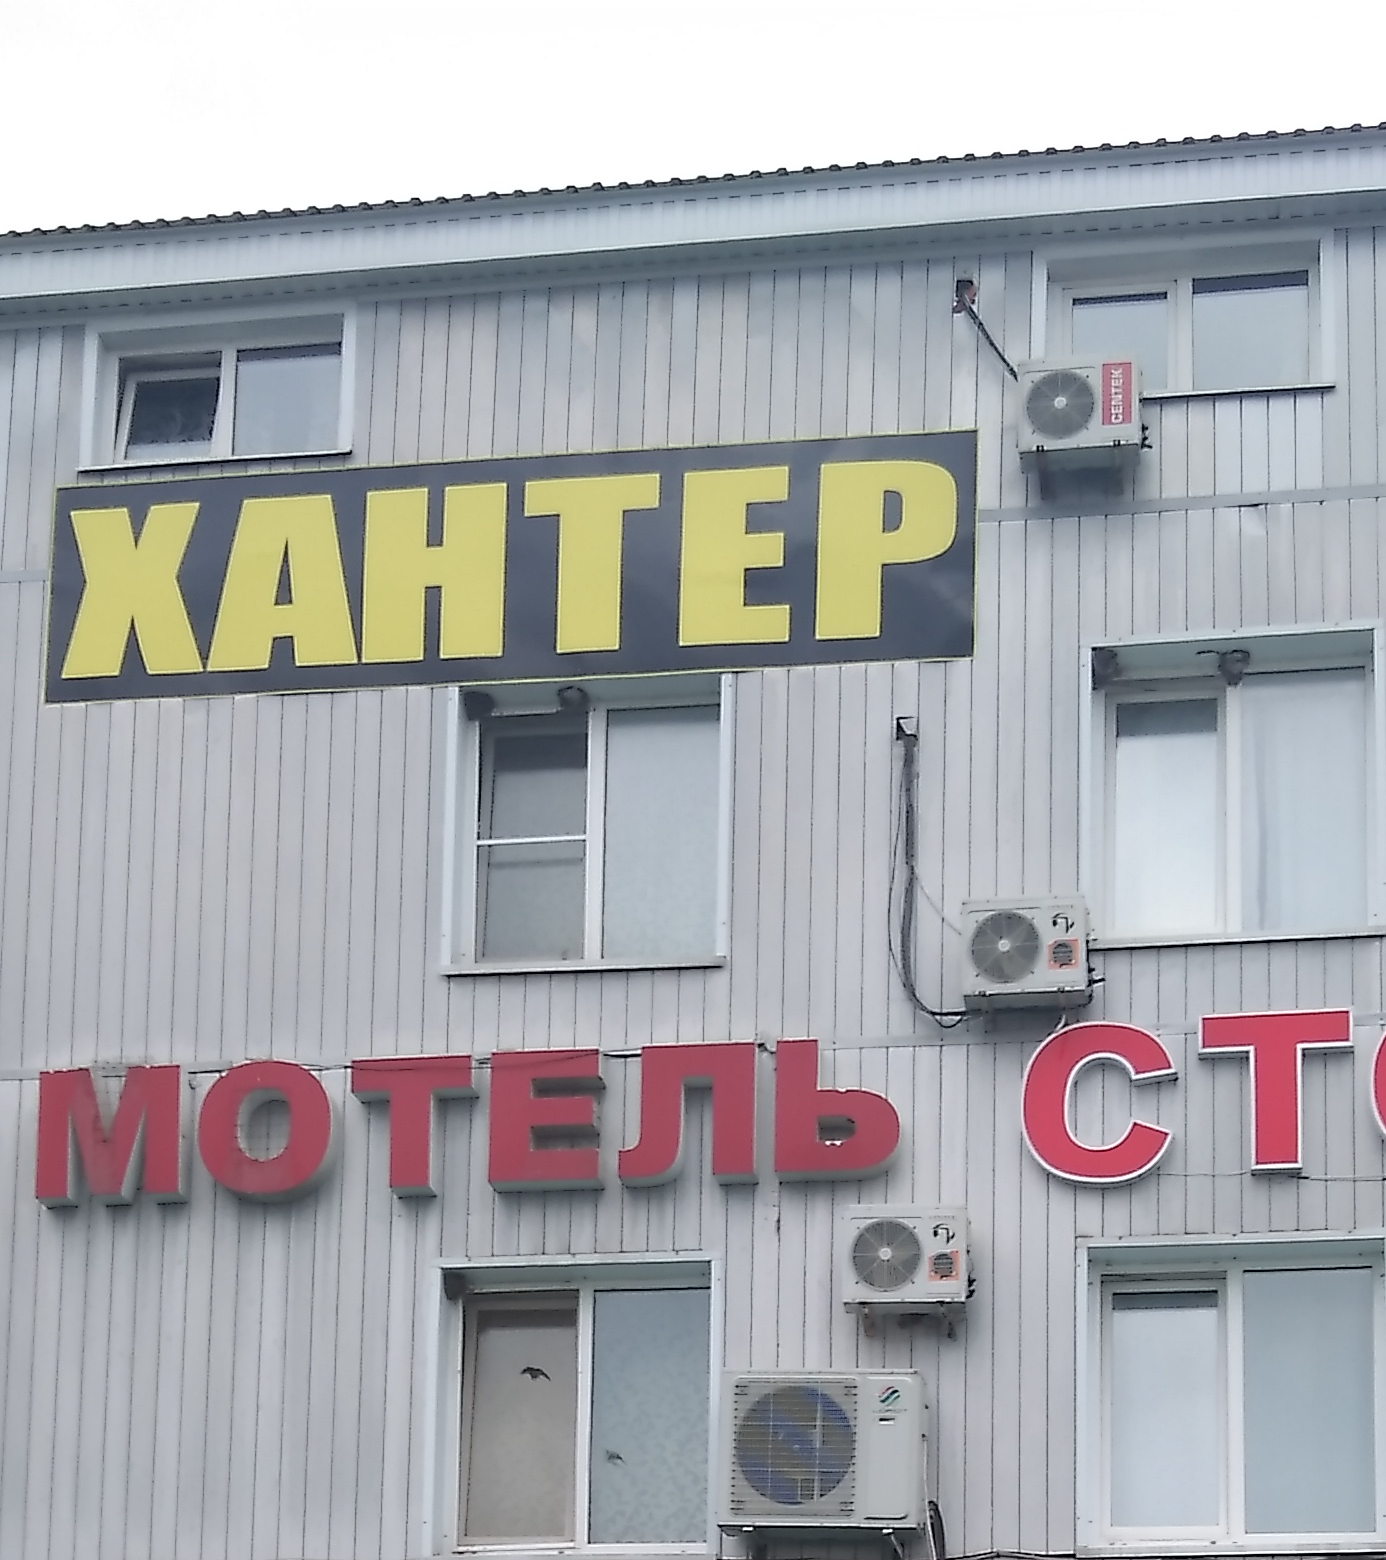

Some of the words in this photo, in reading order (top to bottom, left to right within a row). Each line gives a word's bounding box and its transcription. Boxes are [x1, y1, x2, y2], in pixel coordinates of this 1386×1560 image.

[1111, 368, 1123, 424] CENTEK
[60, 460, 959, 680] ХАНТЕР
[34, 1037, 902, 1208] МОТЕЛЬ
